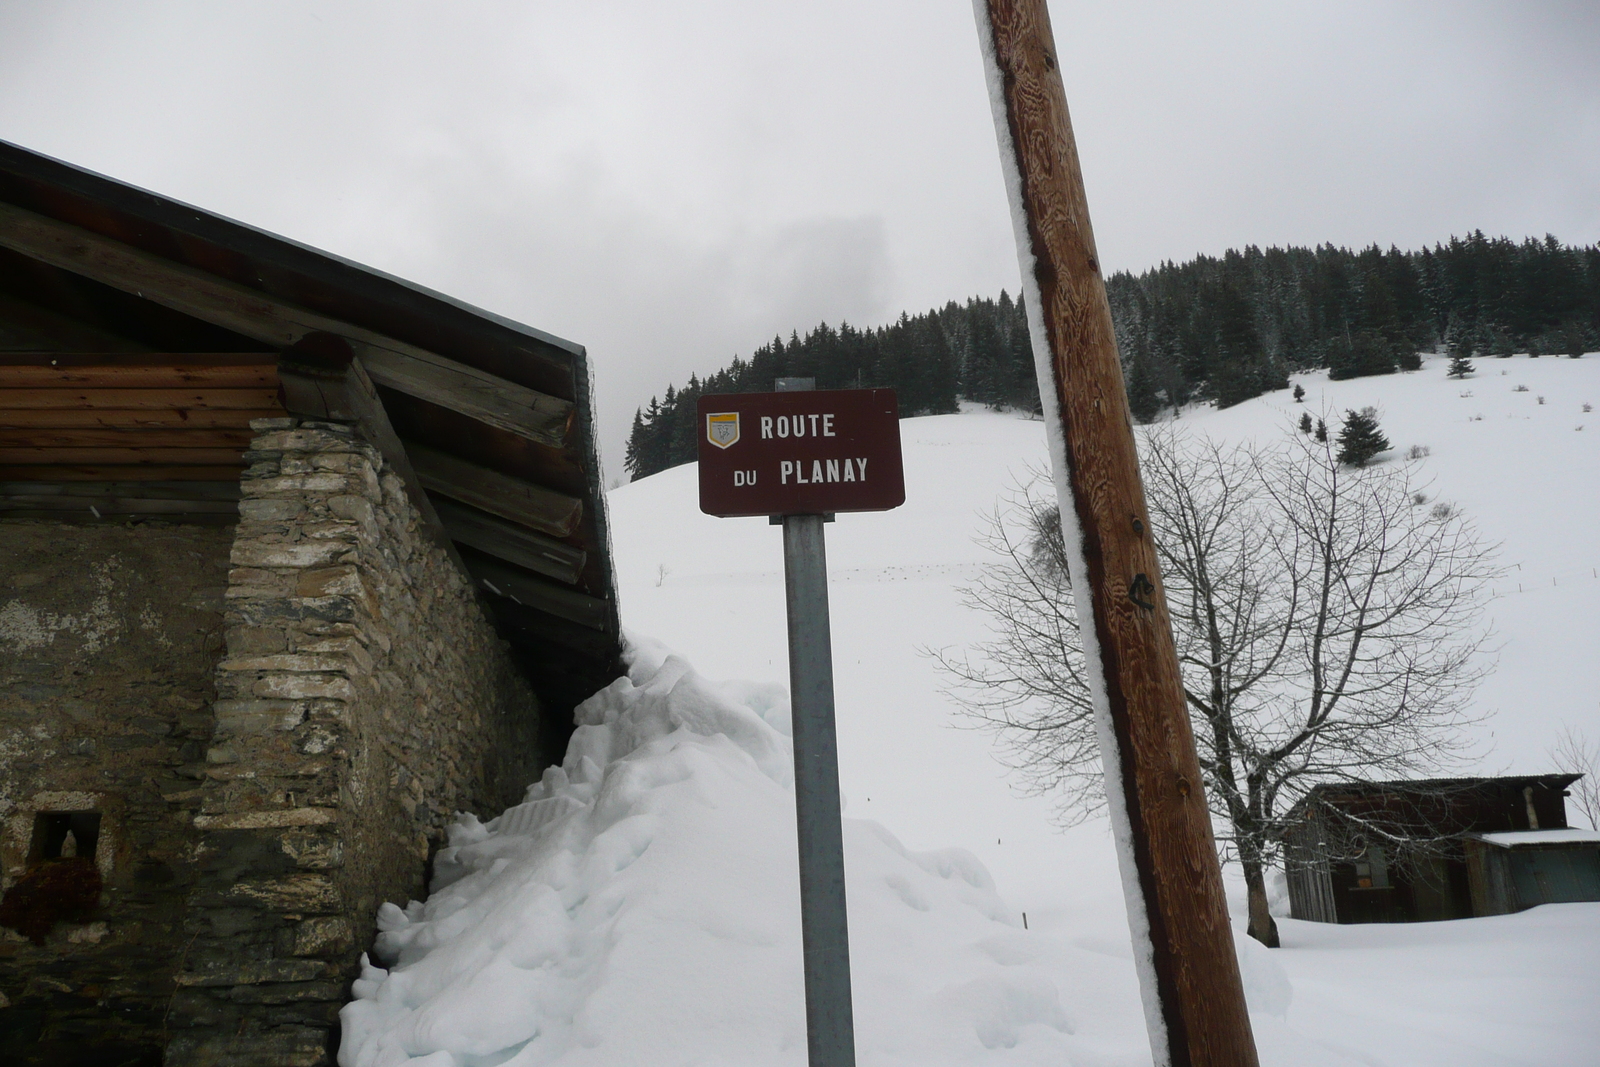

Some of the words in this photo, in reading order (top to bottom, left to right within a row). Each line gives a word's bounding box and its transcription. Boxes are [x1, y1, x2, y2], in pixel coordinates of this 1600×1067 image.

[760, 413, 836, 439] ROUTE
[733, 470, 757, 487] DU
[780, 457, 868, 485] PLANAY
